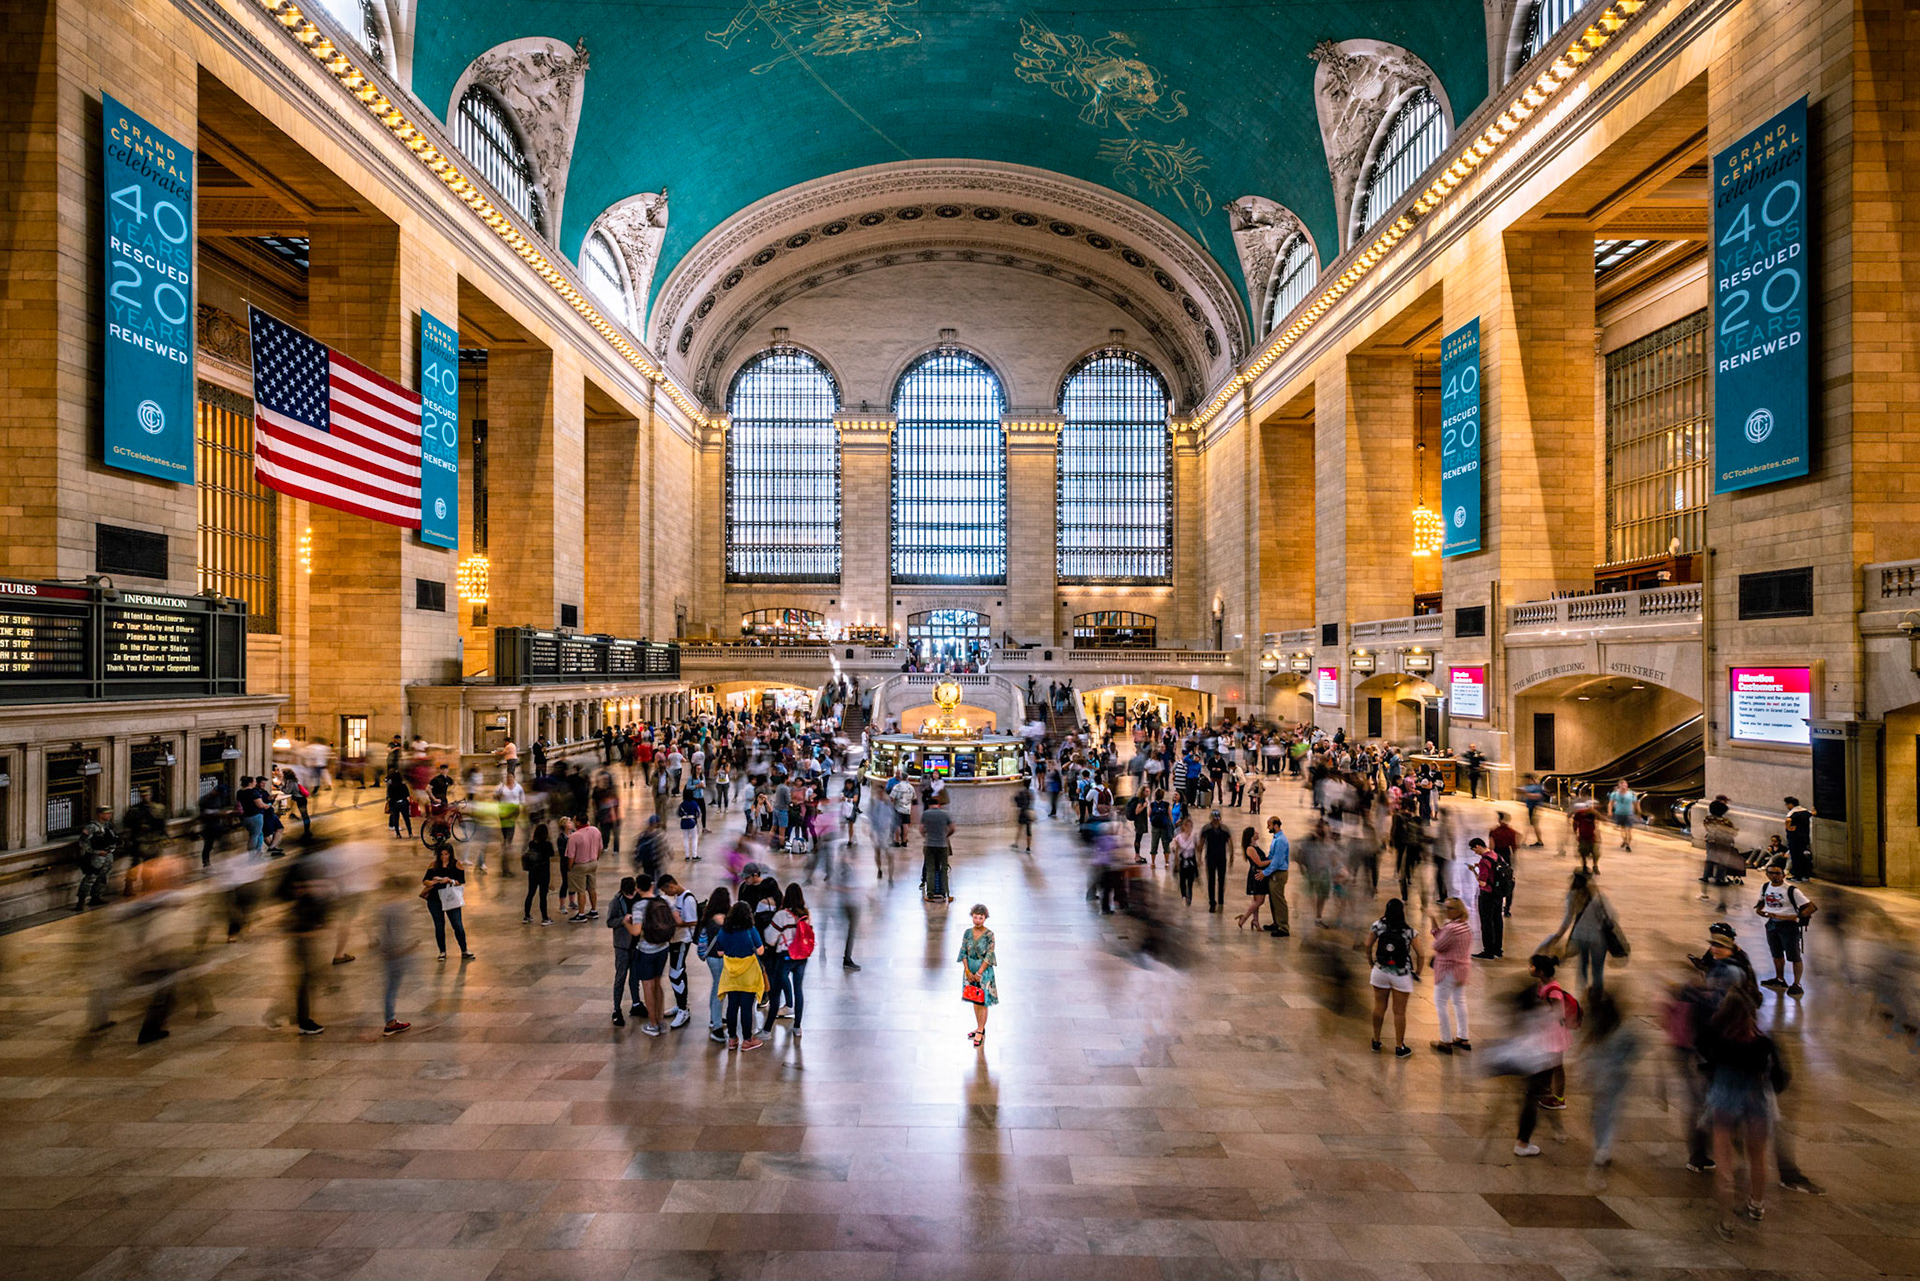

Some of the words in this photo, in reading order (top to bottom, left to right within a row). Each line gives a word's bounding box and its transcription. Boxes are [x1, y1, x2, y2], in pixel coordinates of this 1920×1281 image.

[120, 118, 175, 160] GRAND
[1729, 124, 1786, 167] GRAND
[111, 128, 186, 182] CENTRAL
[1722, 132, 1799, 186] CENTRAL
[108, 144, 190, 202] celebrates
[1718, 145, 1803, 208] celebrates
[111, 184, 188, 244] 40
[1720, 180, 1800, 247] 40
[111, 212, 188, 268] YEARS
[1720, 220, 1800, 274] YEARS
[110, 236, 188, 284] RESCUED
[1720, 242, 1800, 292] RESCUED
[110, 260, 187, 324] 20
[1720, 268, 1800, 336] 20
[110, 300, 188, 348] YEARS
[428, 322, 452, 342] GRAND
[1721, 308, 1800, 354] YEARS
[110, 323, 188, 364] RENEWED
[424, 330, 456, 354] CENTRAL
[1444, 337, 1476, 361] CENTRAL
[1448, 330, 1472, 350] GRAND
[1720, 332, 1800, 373] RENEWED
[424, 362, 456, 396] 40
[1444, 366, 1477, 400] 40
[424, 382, 456, 410] YEARS
[1444, 392, 1476, 416] YEARS
[424, 398, 456, 421] RESCUED
[1443, 406, 1477, 428] RESCUED
[424, 412, 456, 447] 20
[1444, 420, 1476, 456] 20
[113, 446, 187, 470] GCTcelebrates.com
[424, 438, 456, 462] YEARS
[424, 452, 456, 472] RENEWED
[1444, 446, 1477, 470] YEARS
[1443, 461, 1477, 480] RENEWED
[1722, 456, 1800, 480] GCTcelebrates.com
[124, 594, 188, 608] INFORMATION
[12, 616, 30, 624] STOP
[123, 612, 153, 620] Attention
[126, 622, 140, 630] Your
[143, 623, 162, 632] Safety
[12, 640, 30, 648] STOP
[17, 628, 35, 636] EAST
[126, 633, 147, 641] Please
[158, 634, 168, 642] Not
[12, 664, 30, 672] STOP
[143, 654, 165, 662] Central
[167, 664, 200, 672] Cooperation
[1513, 680, 1525, 690] THE
[1526, 668, 1551, 683] METLIFE
[1551, 662, 1585, 675] BUILDING
[1610, 662, 1630, 673] 45TH
[1632, 665, 1666, 681] STREET
[1738, 674, 1774, 682] Attention
[1738, 683, 1783, 691] Customers:
